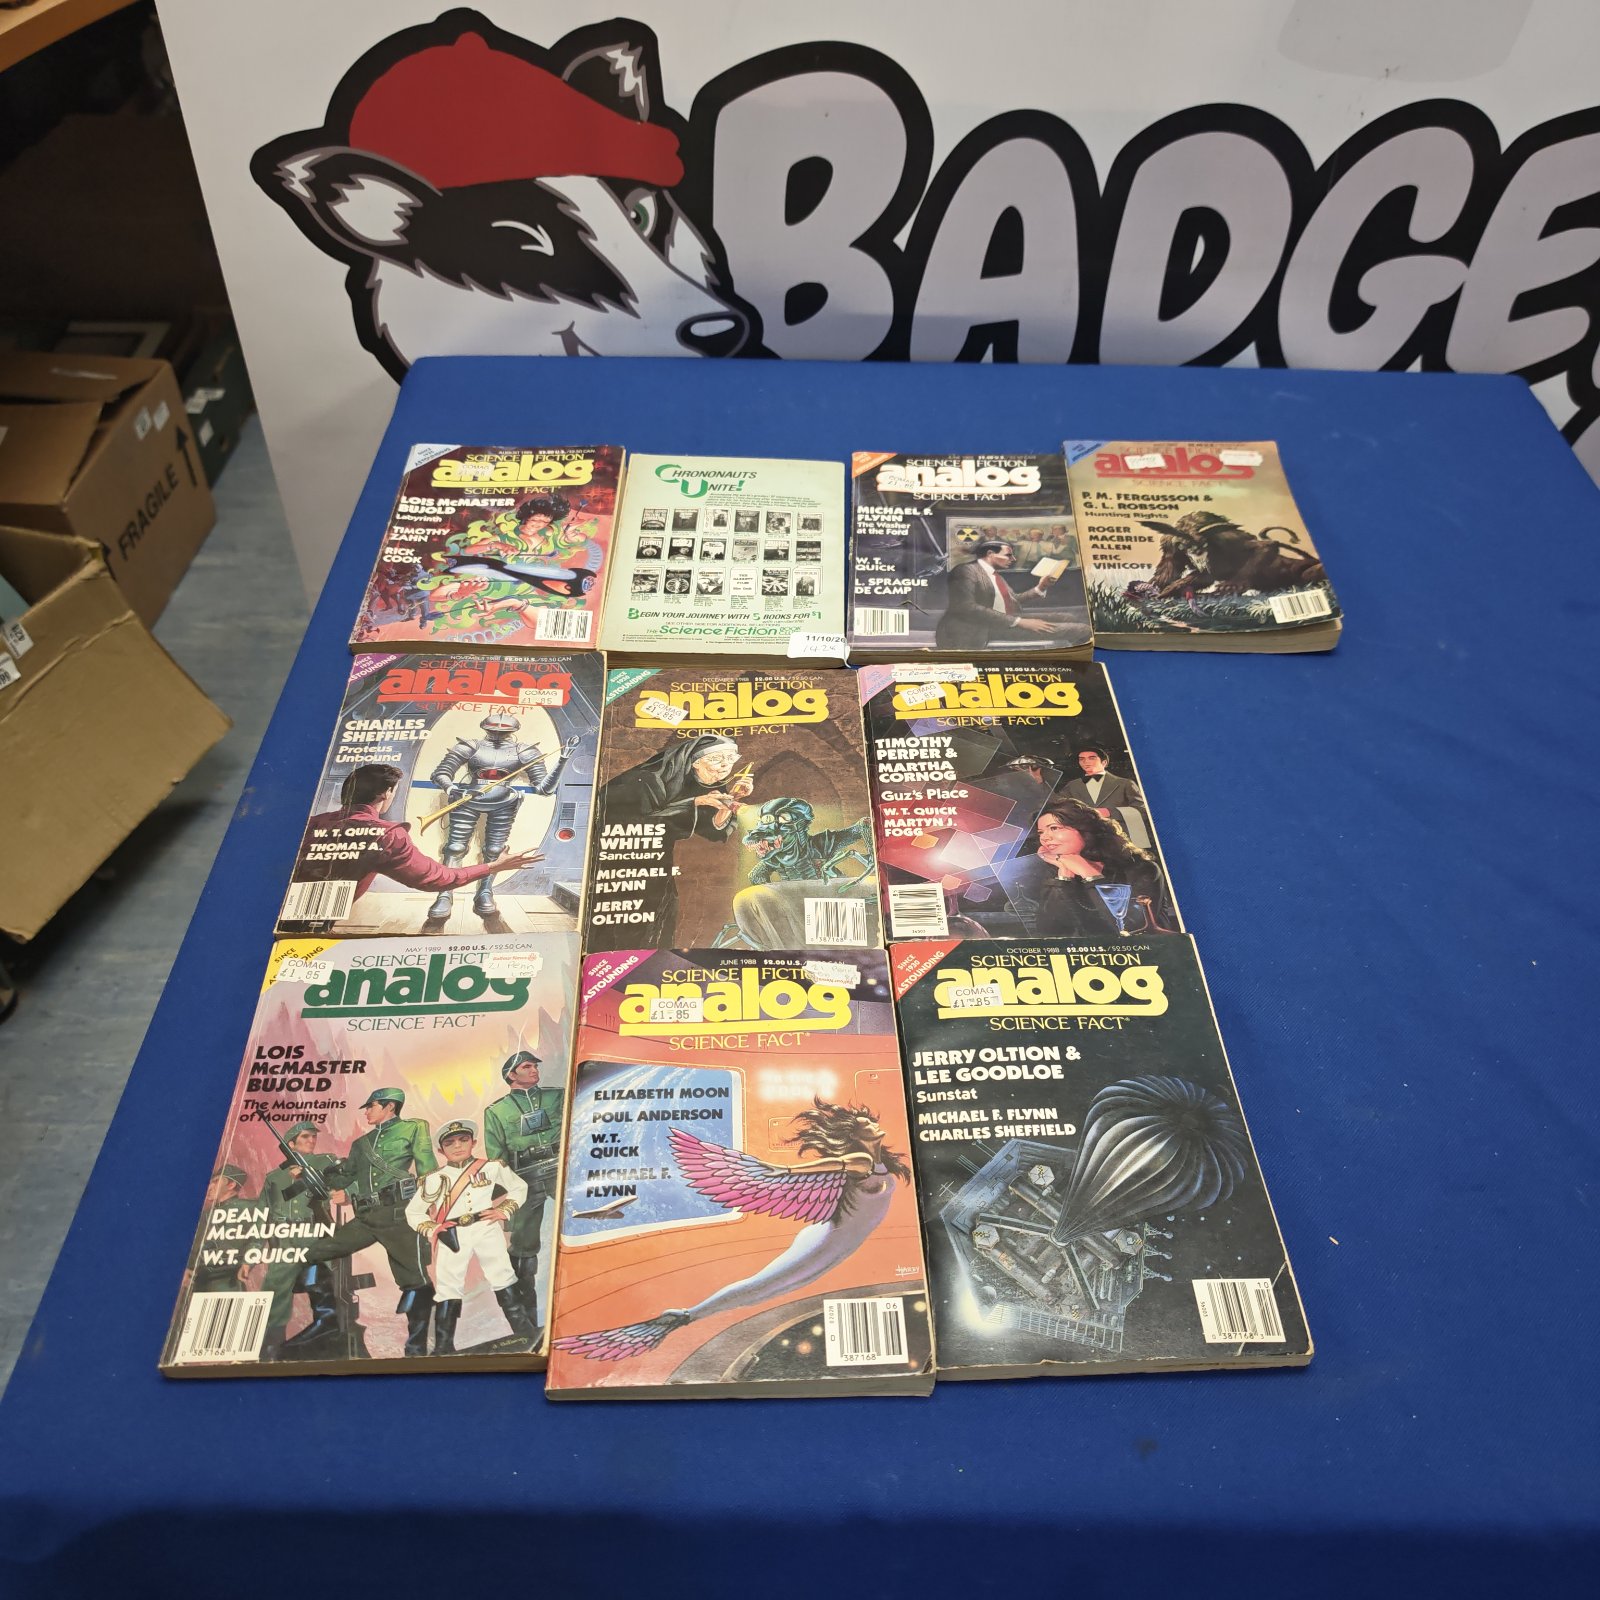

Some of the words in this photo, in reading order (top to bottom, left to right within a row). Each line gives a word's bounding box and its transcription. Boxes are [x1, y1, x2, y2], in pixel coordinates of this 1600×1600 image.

[466, 454, 520, 462] SCIENCE
[535, 453, 585, 461] FICTION
[906, 459, 960, 468] SCIENCE
[977, 459, 1027, 467] FICTION
[655, 464, 757, 483] CHRONONAUTS
[463, 487, 519, 495] SCIENCE
[524, 486, 557, 494] FACT
[681, 479, 745, 498] UNITE!
[400, 495, 434, 506] LOIS
[436, 498, 515, 506] McMASTER
[912, 492, 969, 501] SCIENCE
[974, 492, 1006, 500] FACT
[1096, 492, 1112, 501] M.
[1116, 493, 1200, 502] FERGUSSON
[117, 463, 180, 562] FRAGILE
[397, 504, 456, 515] BUJOLD
[857, 506, 920, 516] MICHAEL
[1118, 502, 1180, 511] ROBSON
[396, 513, 442, 522] Labyrinth
[856, 514, 904, 522] FLYNN
[1085, 511, 1131, 520] Hunting
[1133, 512, 1169, 521] Rights
[393, 526, 450, 536] TIMOTHY
[866, 528, 879, 536] the
[880, 528, 909, 536] Ford
[874, 522, 911, 530] Washer
[1088, 526, 1131, 534] ROGER
[389, 533, 429, 542] ZAHN
[1089, 534, 1154, 543] MACBRIDE
[384, 547, 415, 556] RICK
[1091, 543, 1132, 551] ALLEN
[382, 555, 423, 564] COOK
[1092, 554, 1122, 562] ERIC
[855, 564, 896, 572] QUICK
[1093, 562, 1153, 570] VINICOFF
[866, 578, 929, 587] SPRAGUE
[854, 586, 872, 594] DE
[874, 586, 912, 595] CAMP
[686, 612, 726, 620] JOURNEY
[793, 612, 810, 620] FOR
[659, 625, 722, 635] Science
[724, 626, 778, 636] Fiction
[420, 660, 482, 670] SCIENCE
[501, 662, 561, 672] FICTION
[1004, 674, 1062, 682] FICTION
[606, 670, 652, 702] ASTOUNDING
[670, 681, 736, 692] SCIENCE
[754, 680, 814, 691] FICTION
[892, 674, 1083, 720] analog
[415, 702, 483, 713] SCIENCE
[488, 704, 530, 716] FACT
[634, 681, 830, 729] analog
[345, 719, 426, 731] CHARLES
[936, 716, 1003, 727] SCIENCE
[1008, 716, 1049, 726] FACT
[341, 730, 432, 743] SHEFFIELD
[676, 728, 744, 740] SCIENCE
[750, 724, 790, 736] FACT
[875, 736, 952, 748] TIMOTHY
[338, 745, 393, 755] Proteus
[876, 748, 942, 760] PERPER
[944, 748, 958, 759] &
[336, 752, 402, 763] Unbound
[878, 760, 954, 773] MARTHA
[878, 770, 957, 783] CORNOG
[880, 788, 924, 801] Guz's
[926, 788, 968, 800] Place
[914, 806, 958, 816] QUICK
[884, 818, 944, 828] MARTYN
[345, 828, 386, 837] QUICK
[602, 824, 666, 836] JAMES
[884, 828, 924, 837] FOGG
[310, 842, 366, 852] THOMAS
[368, 842, 384, 851] A.
[600, 836, 664, 850] WHITE
[306, 851, 360, 860] EASTON
[598, 852, 666, 861] Sanctuary
[596, 868, 668, 880] MICHAEL
[596, 880, 646, 894] FLYNN
[594, 899, 644, 913] JERRY
[592, 912, 656, 926] OLTION
[274, 948, 296, 964] SINCE
[350, 954, 428, 968] SCIENCE
[897, 954, 916, 970] SINCE
[970, 954, 1048, 968] SCIENCE
[1070, 954, 1141, 966] FICTION
[288, 960, 327, 970] COMAG
[588, 959, 608, 976] SINCE
[596, 964, 612, 978] 1930
[662, 968, 740, 983] SCIENCE
[897, 950, 944, 994] ASTOUNDING
[584, 956, 640, 1003] ASTOUNDING
[934, 954, 1168, 1019] analog
[955, 986, 995, 996] COMAG
[658, 1000, 697, 1010] COMAG
[952, 997, 992, 1008] £1.85
[651, 1009, 690, 1020] £1.85
[346, 1017, 426, 1032] SCIENCE
[432, 1014, 479, 1029] FACT
[989, 1018, 1070, 1031] SCIENCE
[1078, 1016, 1125, 1030] FACT
[668, 1034, 749, 1050] SCIENCE
[757, 1032, 805, 1047] FACT
[256, 1045, 305, 1060] LOIS
[912, 1048, 976, 1068] JERRY
[978, 1046, 1060, 1062] OLTION
[1065, 1046, 1082, 1060] &
[250, 1060, 367, 1076] McMASTER
[914, 1069, 952, 1086] LEE
[956, 1064, 1065, 1082] GOODLOE
[246, 1077, 332, 1093] BUJOLD
[594, 1088, 674, 1101] ELIZABETH
[680, 1086, 730, 1098] MOON
[916, 1088, 978, 1103] Sunstat
[244, 1099, 269, 1110] The
[271, 1099, 347, 1110] Mountains
[258, 1111, 328, 1124] Mourning
[592, 1110, 633, 1124] POUL
[636, 1108, 724, 1122] ANDERSON
[918, 1110, 989, 1125] MICHAEL
[1006, 1107, 1058, 1120] FLYNN
[591, 1133, 621, 1144] W.T.
[920, 1126, 992, 1142] CHARLES
[994, 1123, 1077, 1138] SHEFFIELD
[590, 1146, 640, 1160] QUICK
[586, 1168, 657, 1181] MICHAEL
[586, 1184, 637, 1198] FLYNN
[211, 1207, 270, 1224] DEAN
[206, 1222, 336, 1240] McLAUGHLIN
[203, 1249, 239, 1266] W.T.
[244, 1247, 310, 1264] QUICK
[886, 1302, 898, 1310] 06
[1222, 1332, 1254, 1340] 387168
[844, 1354, 877, 1362] 387168
